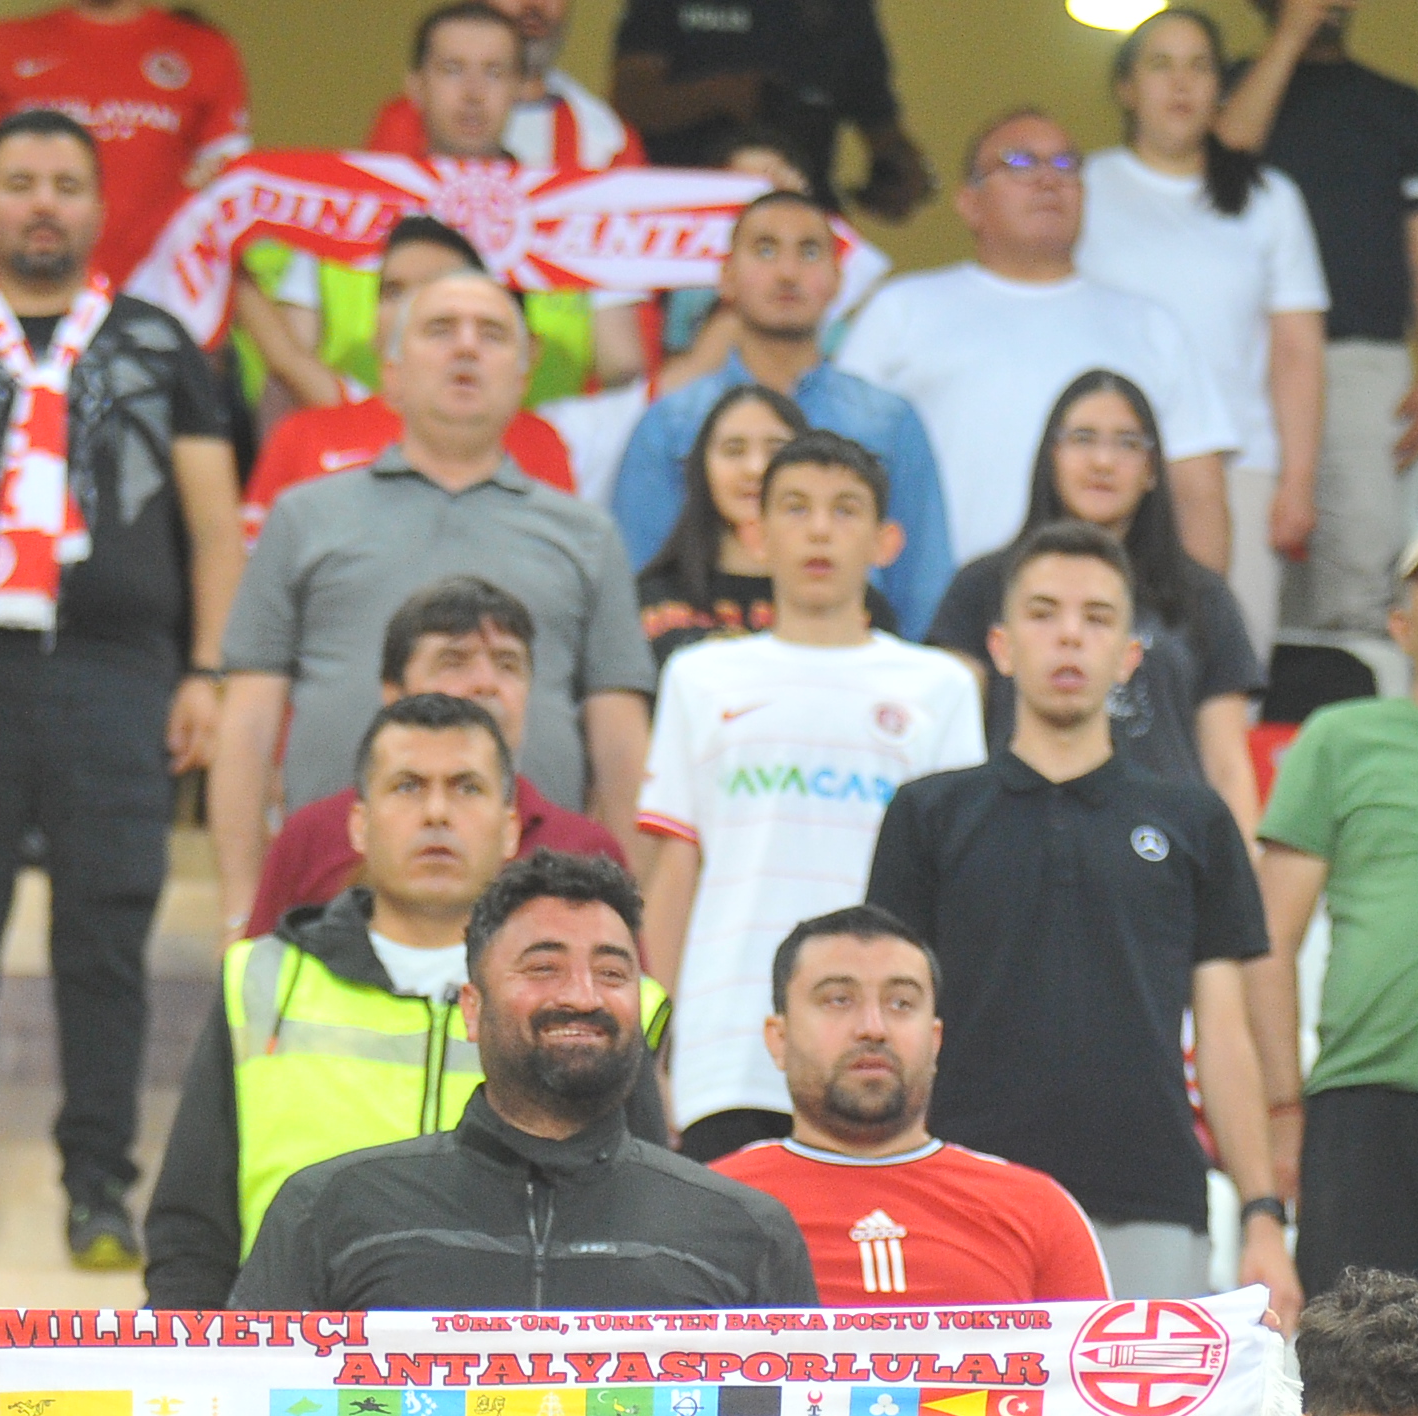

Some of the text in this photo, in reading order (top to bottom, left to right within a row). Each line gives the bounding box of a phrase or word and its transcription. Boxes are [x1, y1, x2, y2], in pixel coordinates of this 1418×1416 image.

[724, 1313, 829, 1336] BAŞKA
[833, 1312, 930, 1331] DOSTU
[934, 1309, 1053, 1331] YOKTUR
[333, 1351, 1050, 1387] ANTALYASPORLULAR
